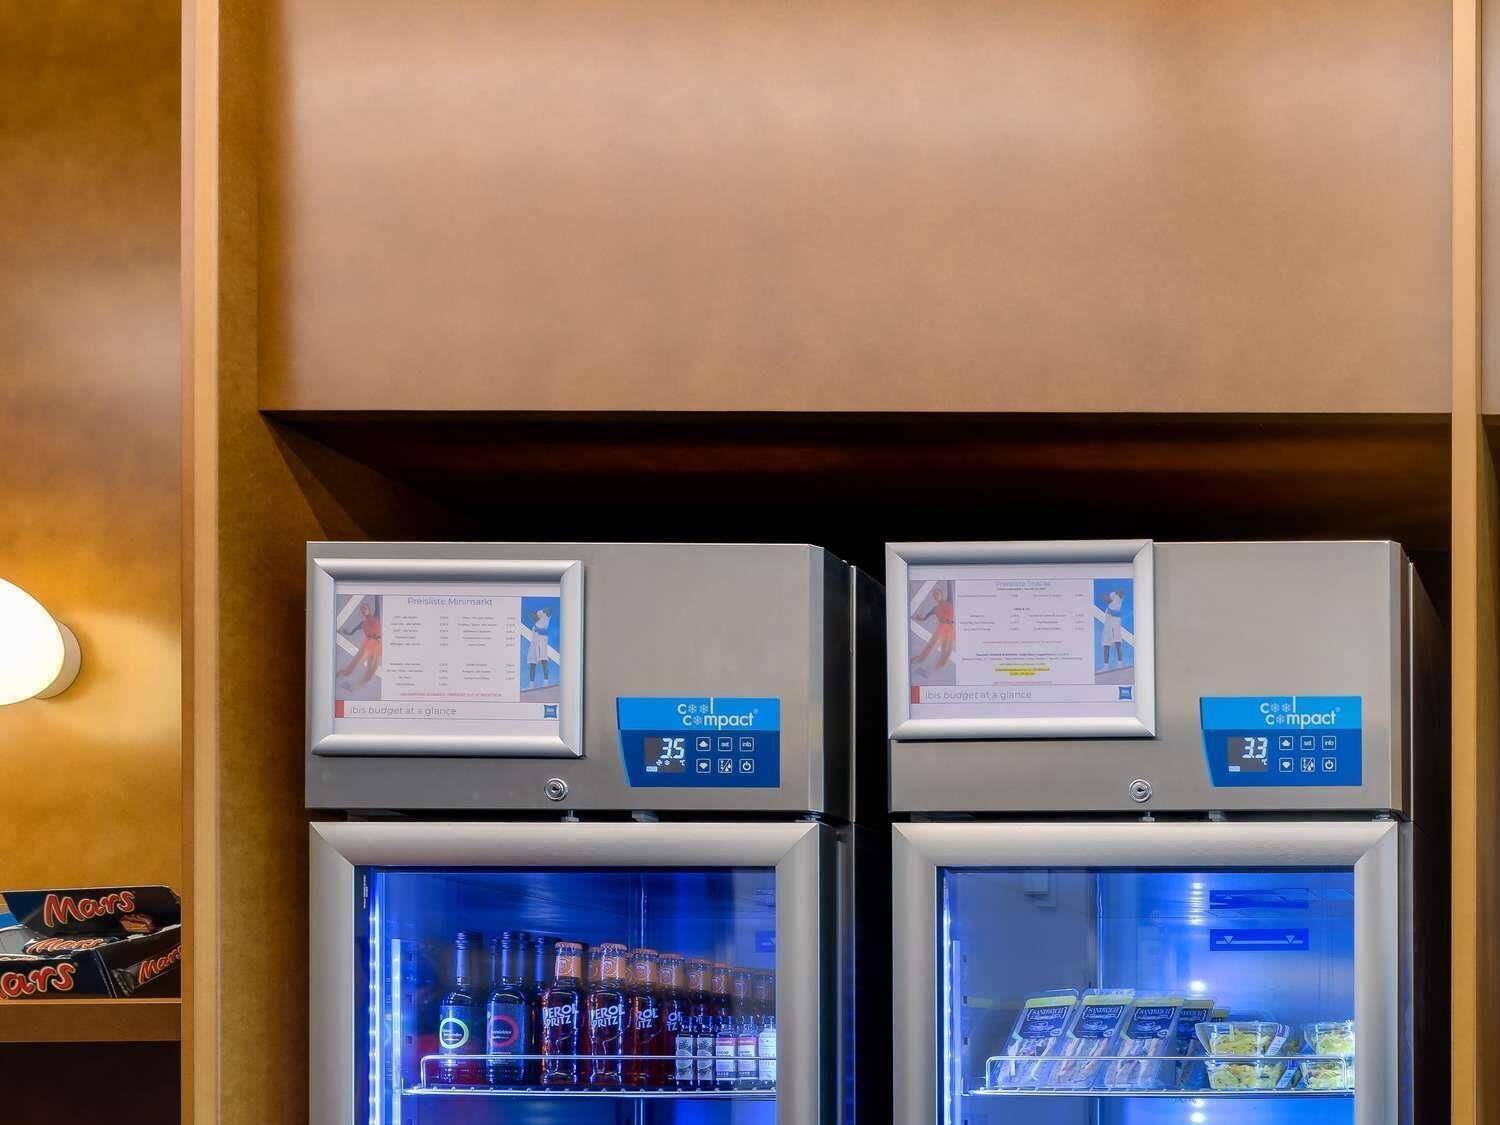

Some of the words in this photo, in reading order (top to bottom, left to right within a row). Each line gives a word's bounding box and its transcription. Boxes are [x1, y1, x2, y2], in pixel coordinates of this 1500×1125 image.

[943, 690, 977, 701] budget
[1000, 690, 1032, 701] glance
[368, 706, 402, 716] budget
[425, 706, 457, 717] glance
[43, 891, 135, 928] Mars
[0, 963, 76, 999] ars
